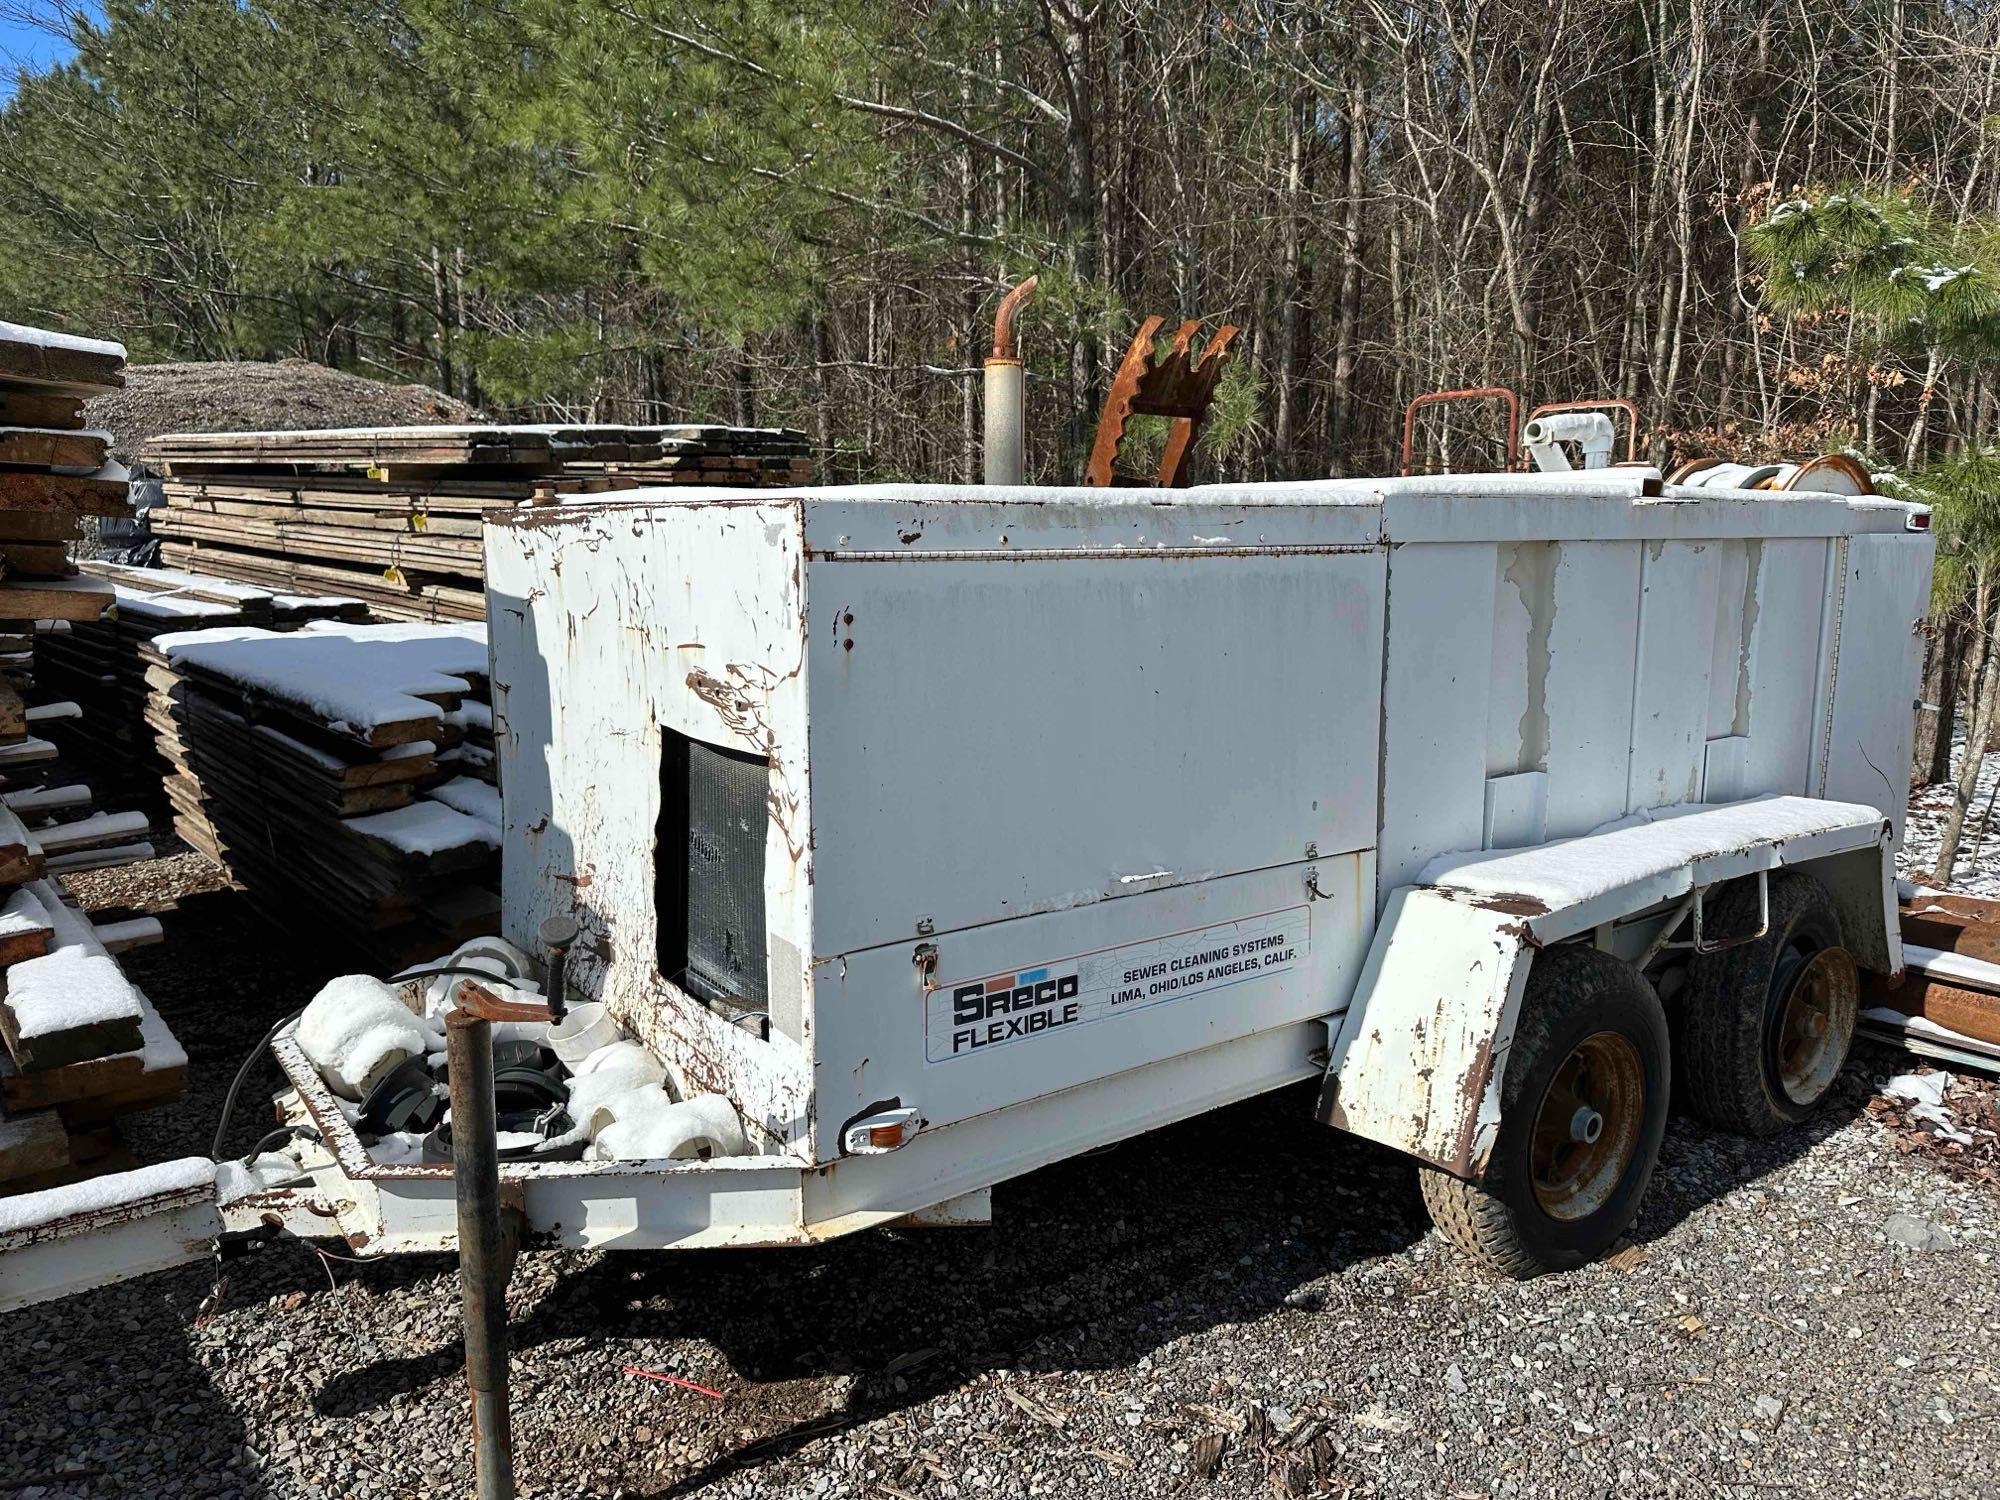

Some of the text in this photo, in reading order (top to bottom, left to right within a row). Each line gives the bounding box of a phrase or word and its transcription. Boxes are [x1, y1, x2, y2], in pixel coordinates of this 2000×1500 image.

[1111, 948, 1297, 1006] LIMA, OHIO/LOS ANGELES, CALIF.
[1124, 934, 1284, 983] SEWER CLEANING SYSTEMS
[953, 1003, 1078, 1053] FLEXIBLE
